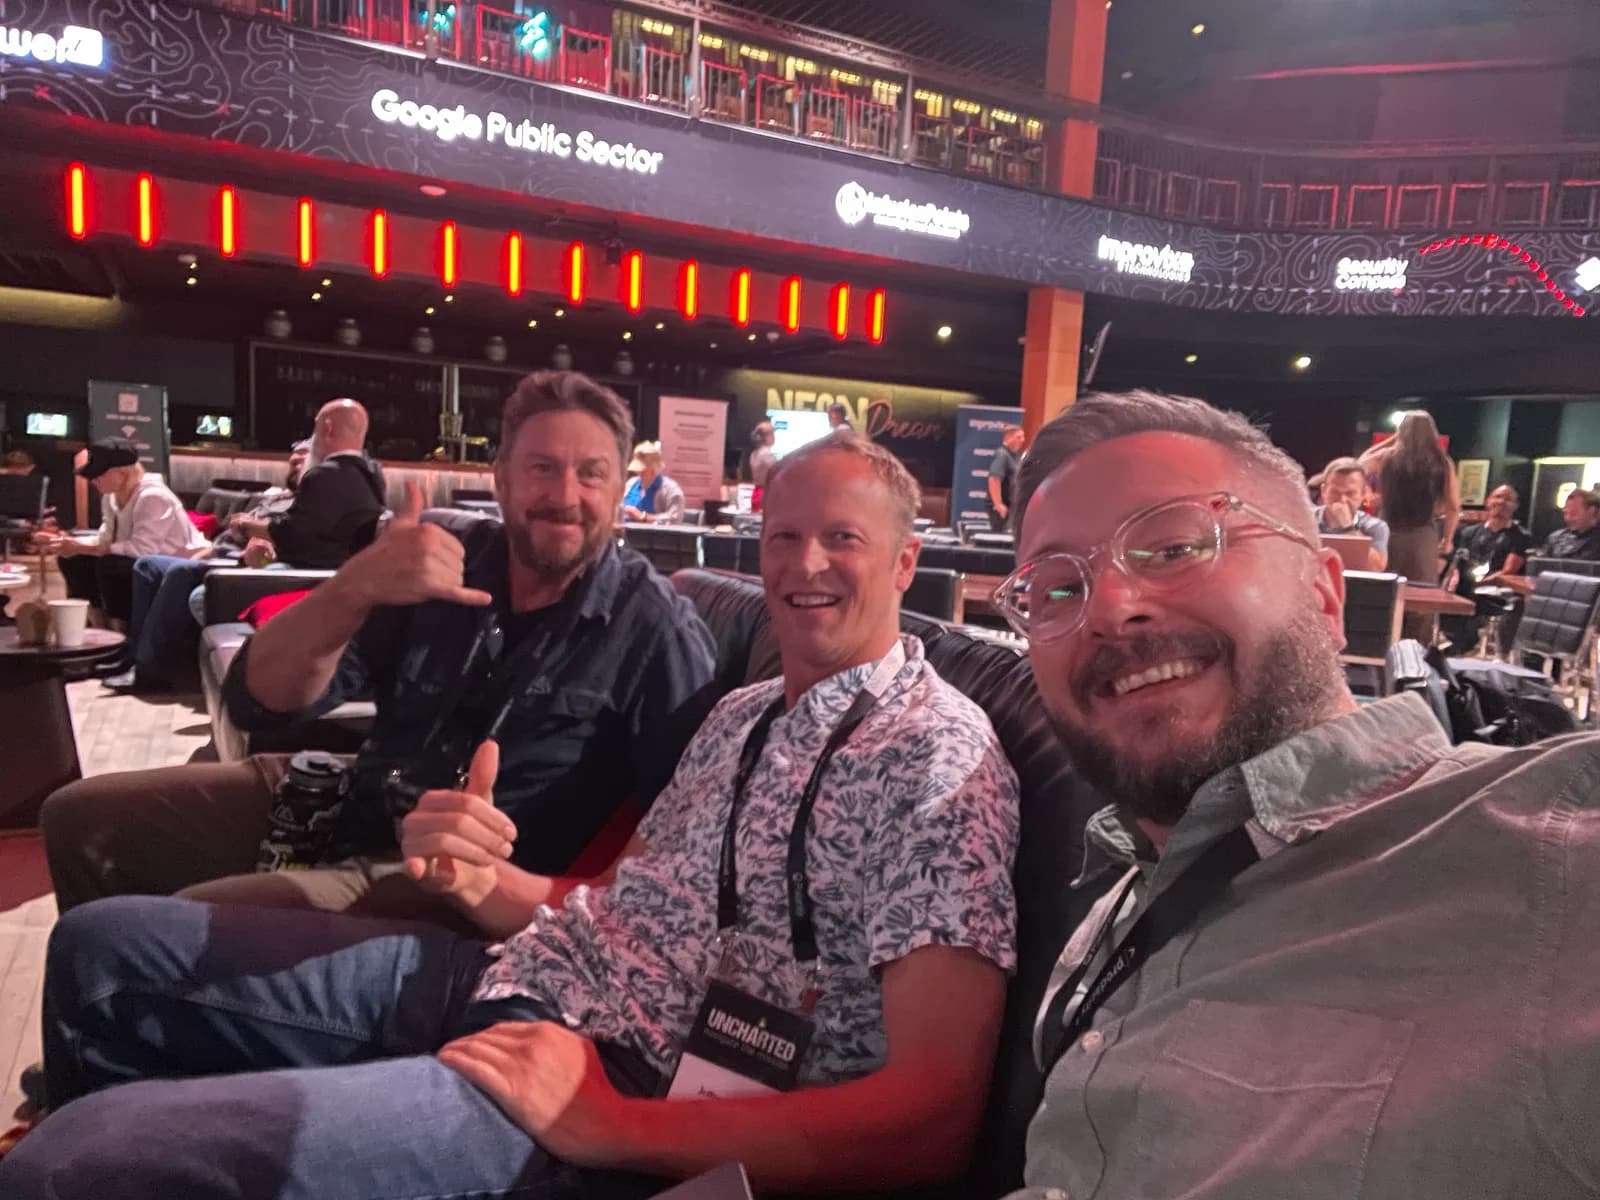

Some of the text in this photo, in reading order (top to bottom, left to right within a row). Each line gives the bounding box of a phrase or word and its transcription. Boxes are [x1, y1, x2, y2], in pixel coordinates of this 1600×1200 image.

[371, 89, 664, 174] Google Public Sector
[707, 1007, 797, 1062] UNCHARTED
